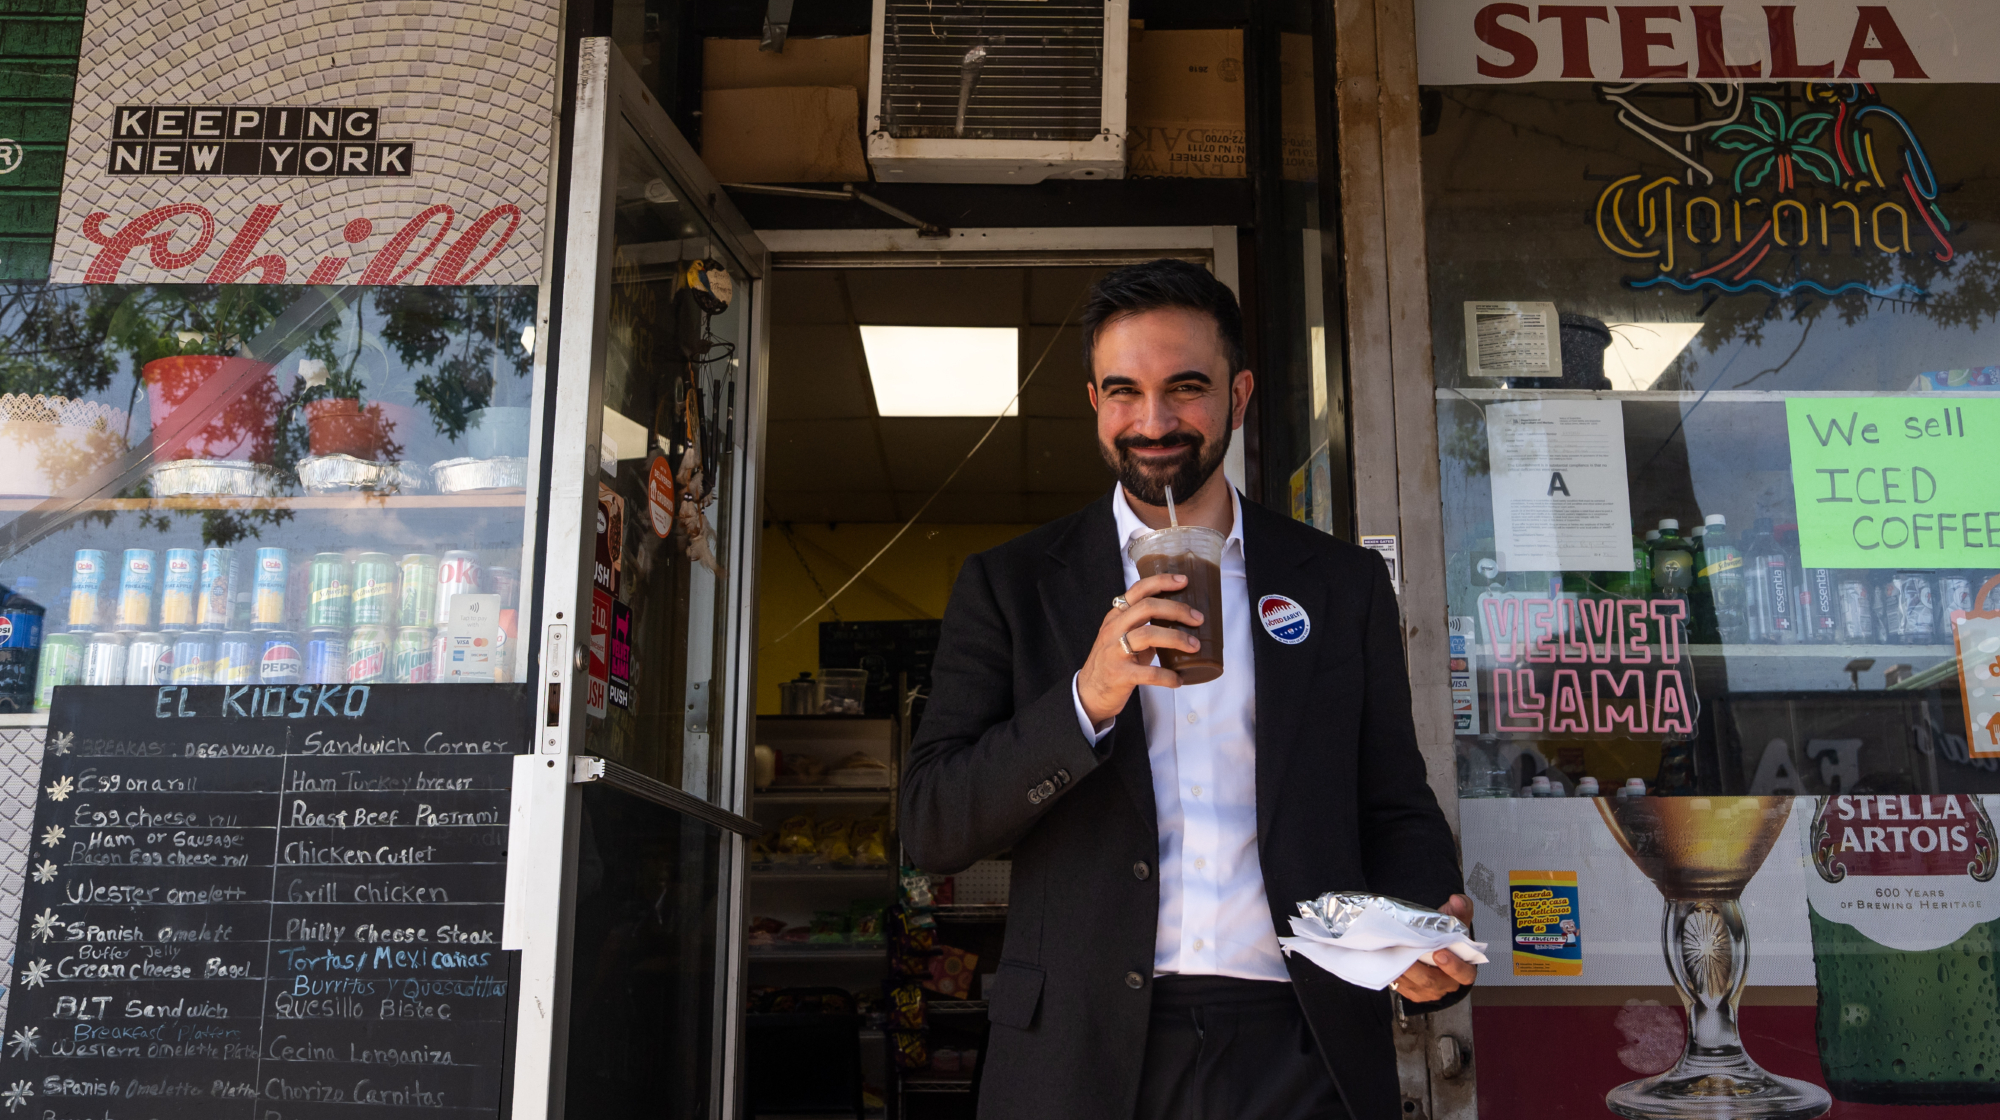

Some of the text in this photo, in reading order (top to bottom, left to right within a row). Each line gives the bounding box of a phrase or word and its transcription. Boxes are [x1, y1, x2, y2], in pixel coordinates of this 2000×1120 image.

[1473, 2, 1930, 79] STELLA
[119, 109, 374, 137] KEEPING
[114, 145, 407, 172] NEW YORK
[1169, 153, 1210, 162] STREET
[1596, 174, 1912, 272] Corona
[82, 202, 522, 284] Chill
[1806, 406, 1964, 447] We sell
[1547, 472, 1570, 496] A
[1815, 466, 1937, 504] ICED
[1852, 511, 2000, 551] COFFEE
[1774, 569, 1786, 614] essentia
[1817, 568, 1831, 613] essentia
[1483, 598, 1686, 664] VELVET
[612, 637, 630, 662] VELVET
[156, 684, 370, 719] EL KIOSKO
[609, 685, 628, 707] PUSH
[1493, 668, 1693, 733] LLAMA
[301, 731, 508, 755] Sandwich Corner
[77, 768, 121, 793] Egg
[292, 769, 337, 792] Ham
[74, 803, 121, 827] Egg
[125, 805, 199, 829] cheese
[290, 799, 349, 829] Roast
[1837, 795, 1965, 820] STELLA
[88, 831, 135, 850] Ham
[147, 834, 168, 846] or
[1840, 826, 1969, 853] ARTOIS
[284, 841, 372, 865] Chicken
[288, 879, 337, 903] Grill
[1513, 889, 1552, 900] Recuerda
[1549, 898, 1568, 906] casa
[1875, 888, 1900, 898] 600
[65, 921, 144, 942] Spanish
[436, 924, 494, 944] Steak
[1518, 916, 1558, 927] productos
[203, 956, 251, 979] Bagel
[292, 974, 375, 997] Burritos
[52, 996, 228, 1021] BLT Sandwich
[270, 1035, 454, 1066] Cecina Longaniza
[42, 1075, 121, 1097] Spanish
[353, 1079, 446, 1108] Carnitas
